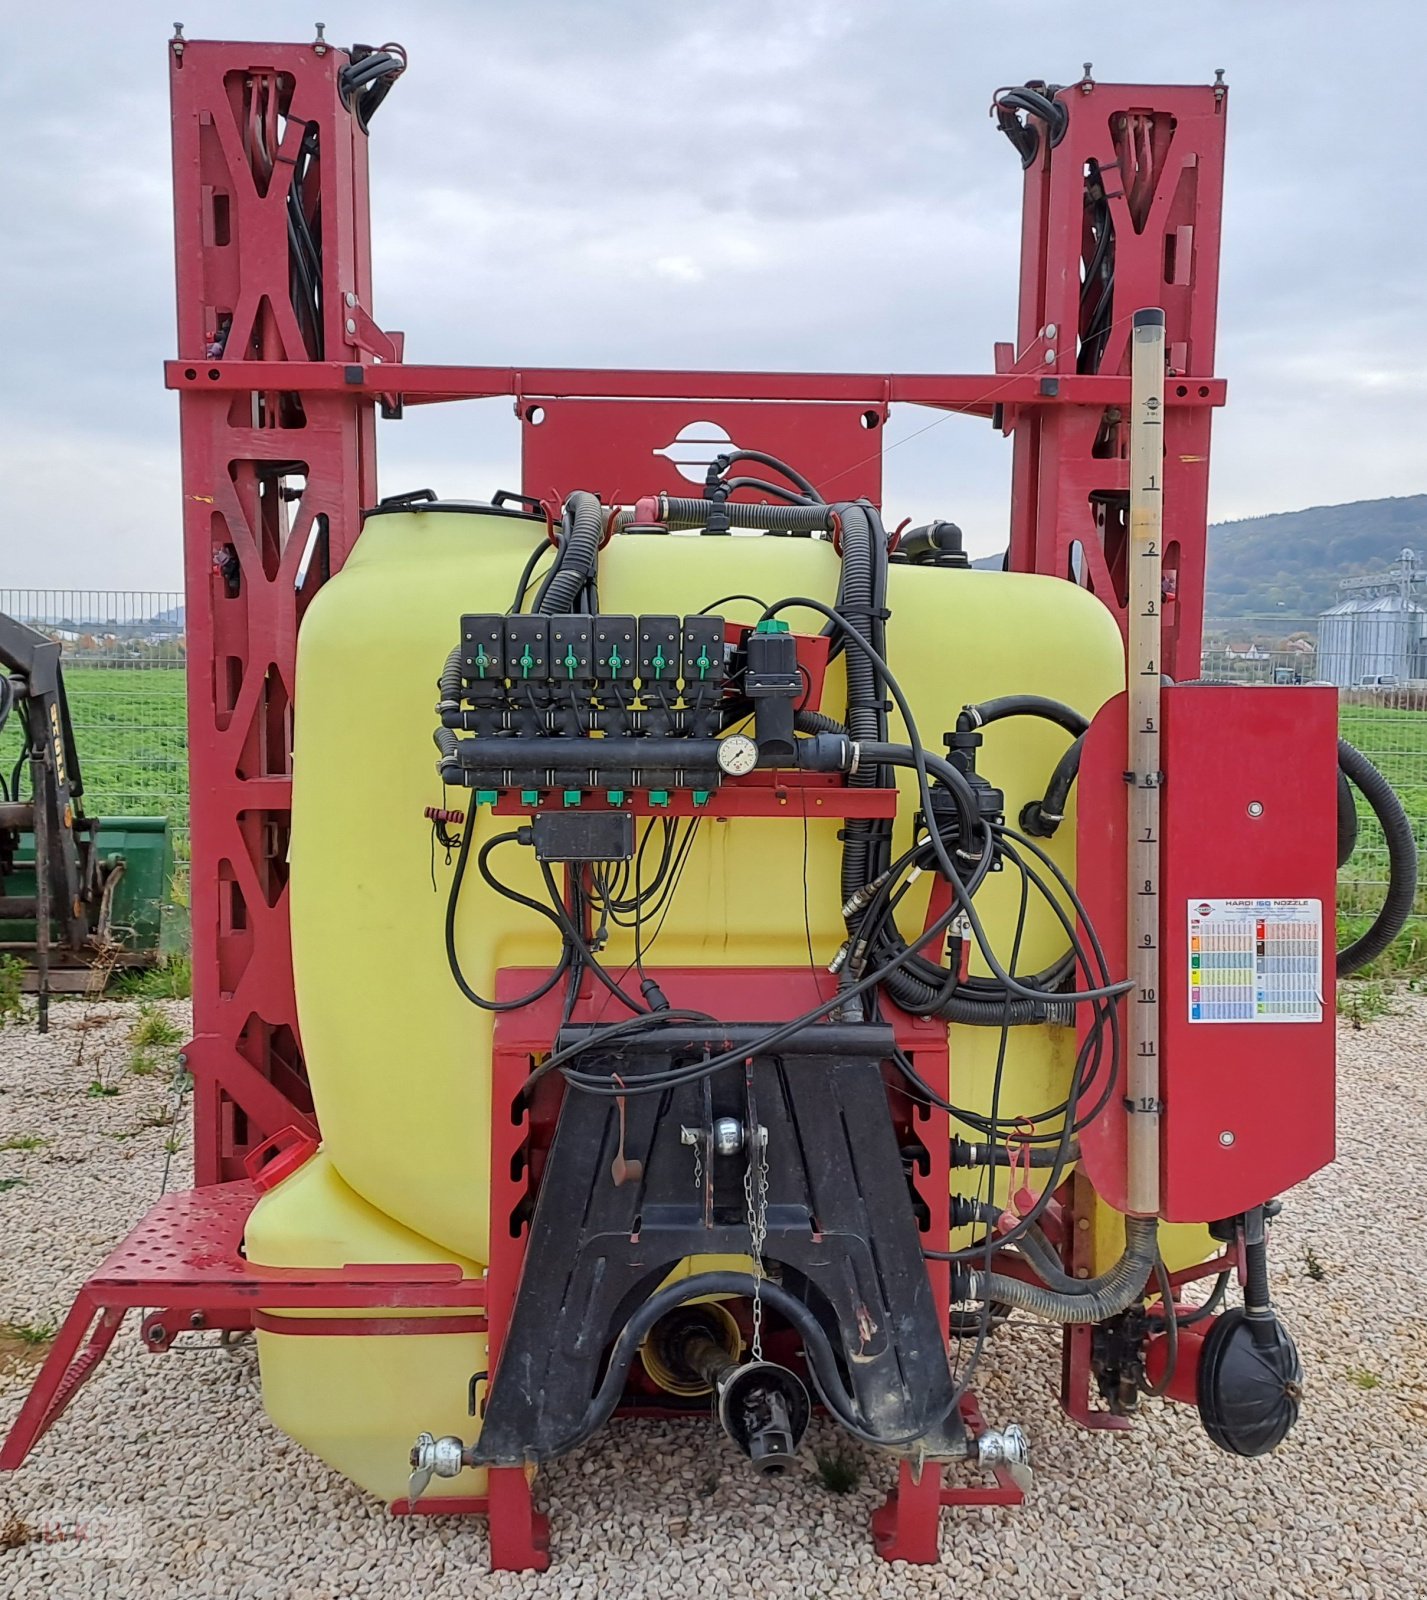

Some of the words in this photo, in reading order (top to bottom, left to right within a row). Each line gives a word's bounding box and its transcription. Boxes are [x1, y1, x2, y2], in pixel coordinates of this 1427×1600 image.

[1149, 475, 1155, 488] 1
[1148, 541, 1156, 554] 2
[1147, 600, 1155, 613] 3
[1146, 660, 1154, 672] 4
[1145, 717, 1154, 730] 5
[1145, 773, 1154, 786] 6
[1144, 827, 1152, 840] 7
[1144, 879, 1152, 892] 8
[1143, 934, 1152, 946] 9
[1140, 988, 1155, 1001] 10
[1140, 1041, 1154, 1054] 11
[1140, 1097, 1154, 1110] 12
